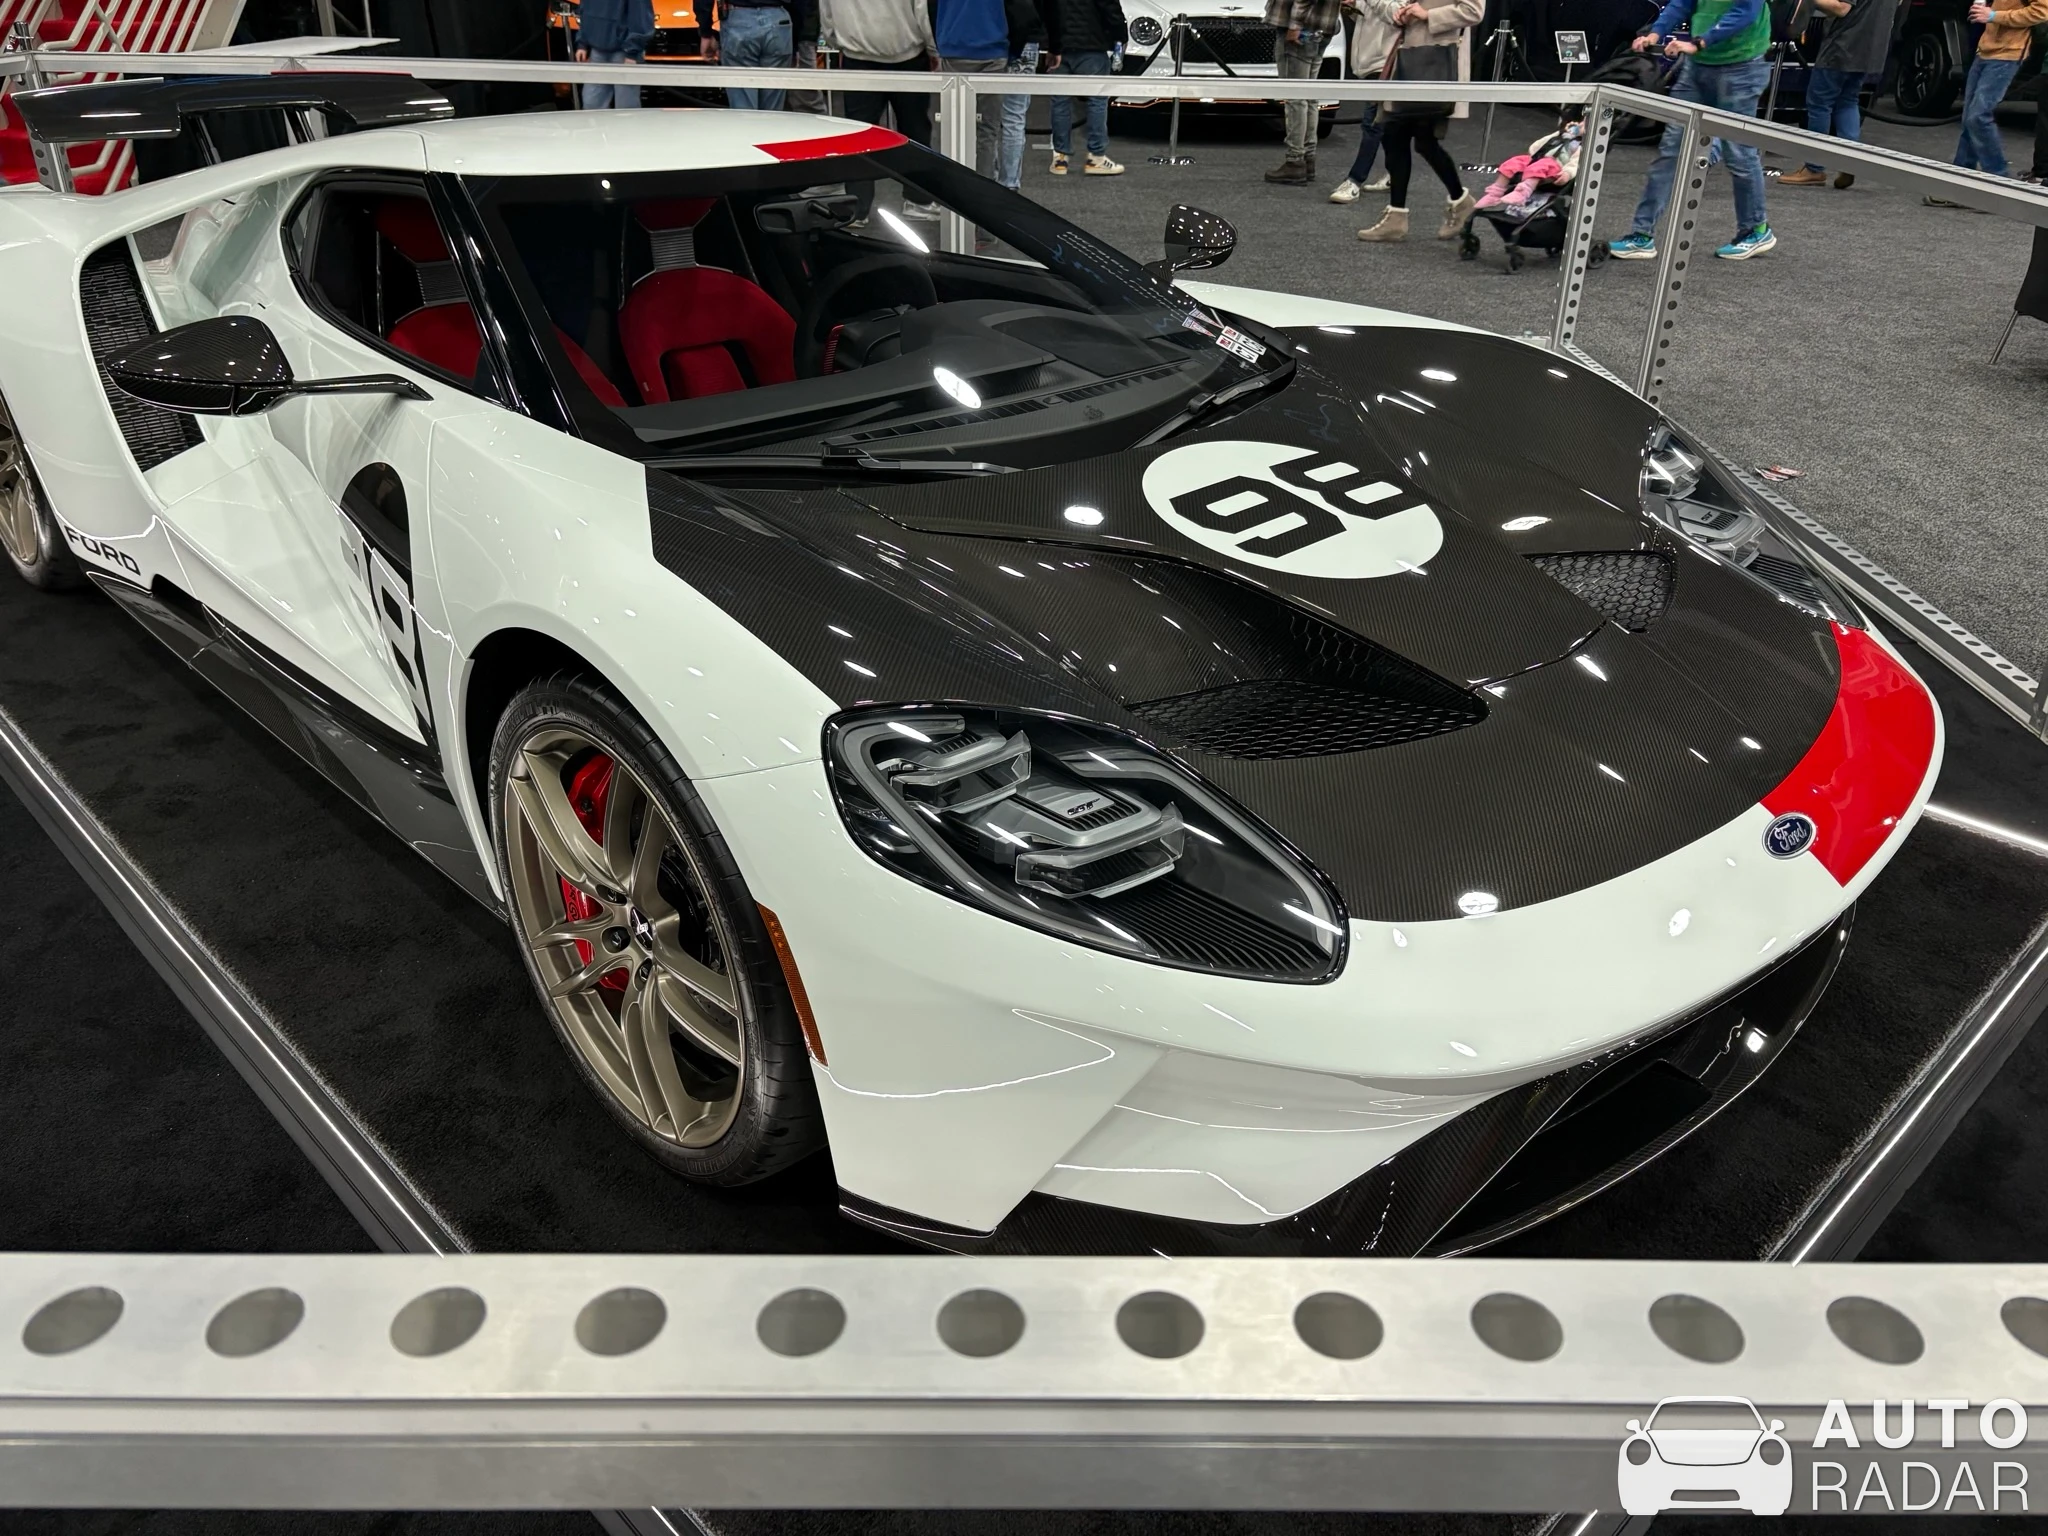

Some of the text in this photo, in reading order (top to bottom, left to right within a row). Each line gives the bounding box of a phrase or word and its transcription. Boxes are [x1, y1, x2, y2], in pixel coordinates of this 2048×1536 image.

[1169, 445, 1440, 559] 98
[64, 525, 141, 577] FORD
[1773, 821, 1808, 851] Ford
